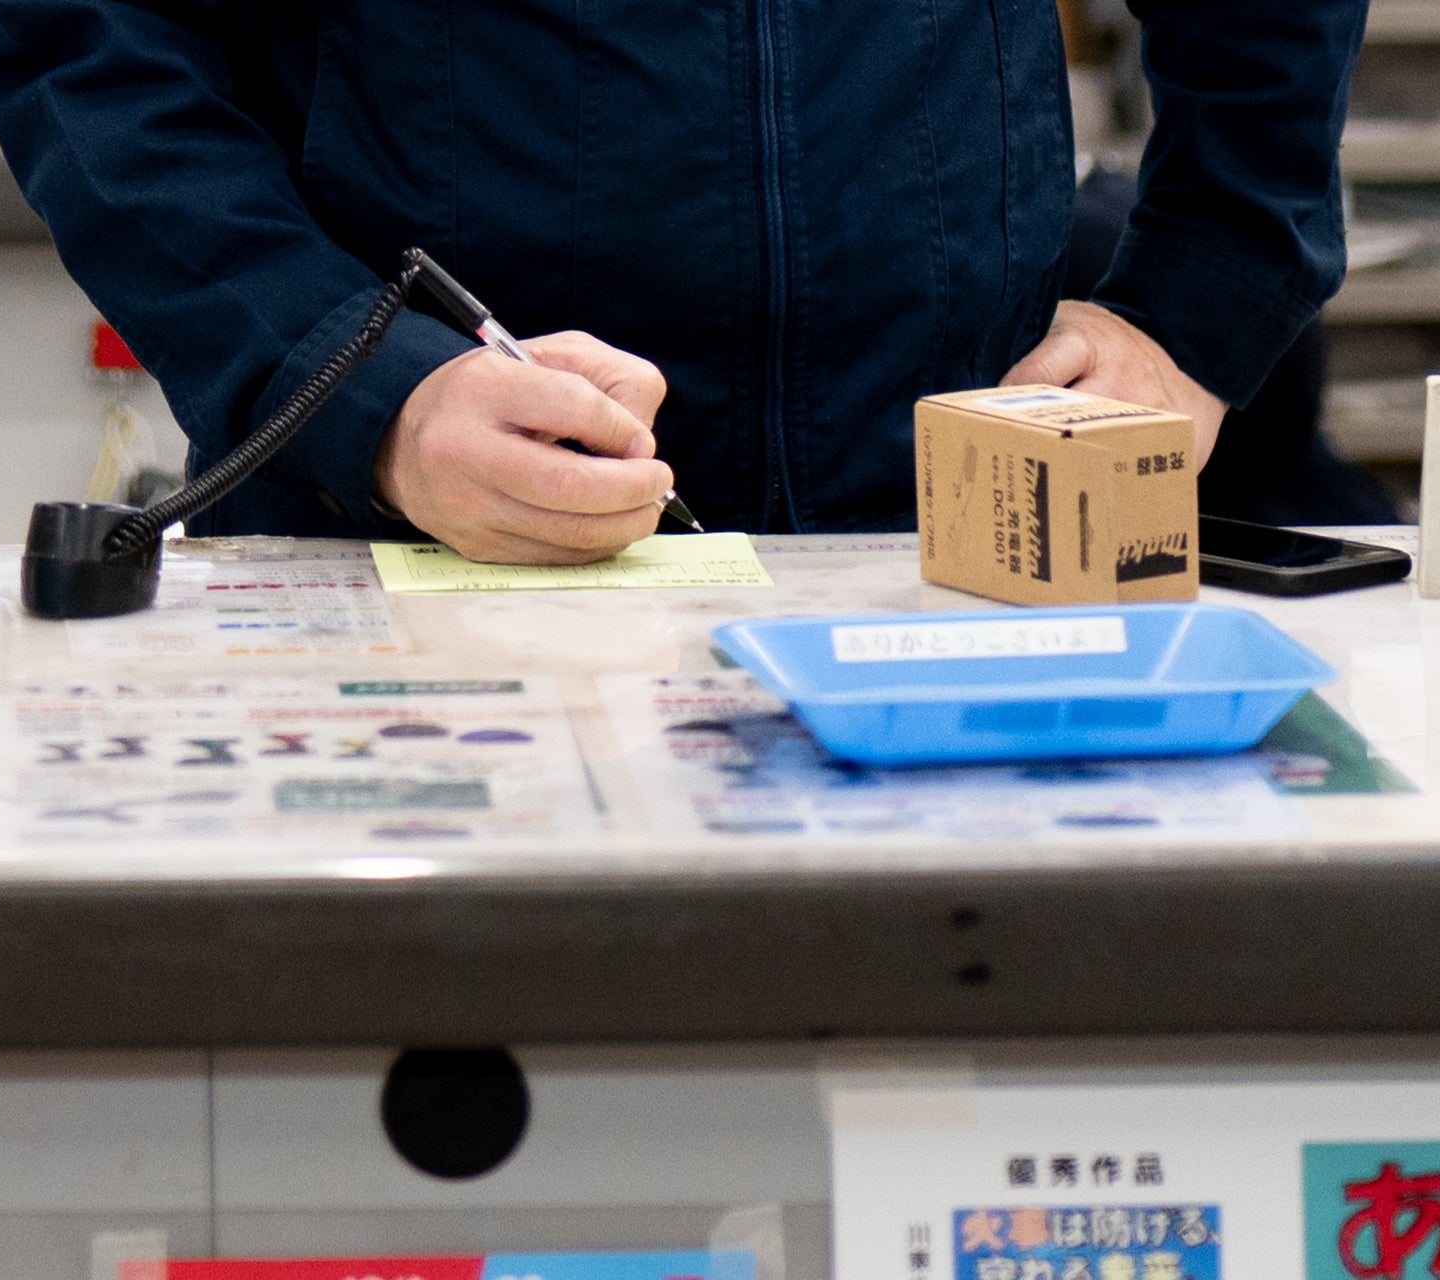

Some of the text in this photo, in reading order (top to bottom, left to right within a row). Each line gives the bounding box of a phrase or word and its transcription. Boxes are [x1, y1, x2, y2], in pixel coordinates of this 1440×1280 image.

[993, 489, 1006, 566] DC1001
[1008, 509, 1022, 575] 充電器
[1008, 1153, 1164, 1186] 優秀作品
